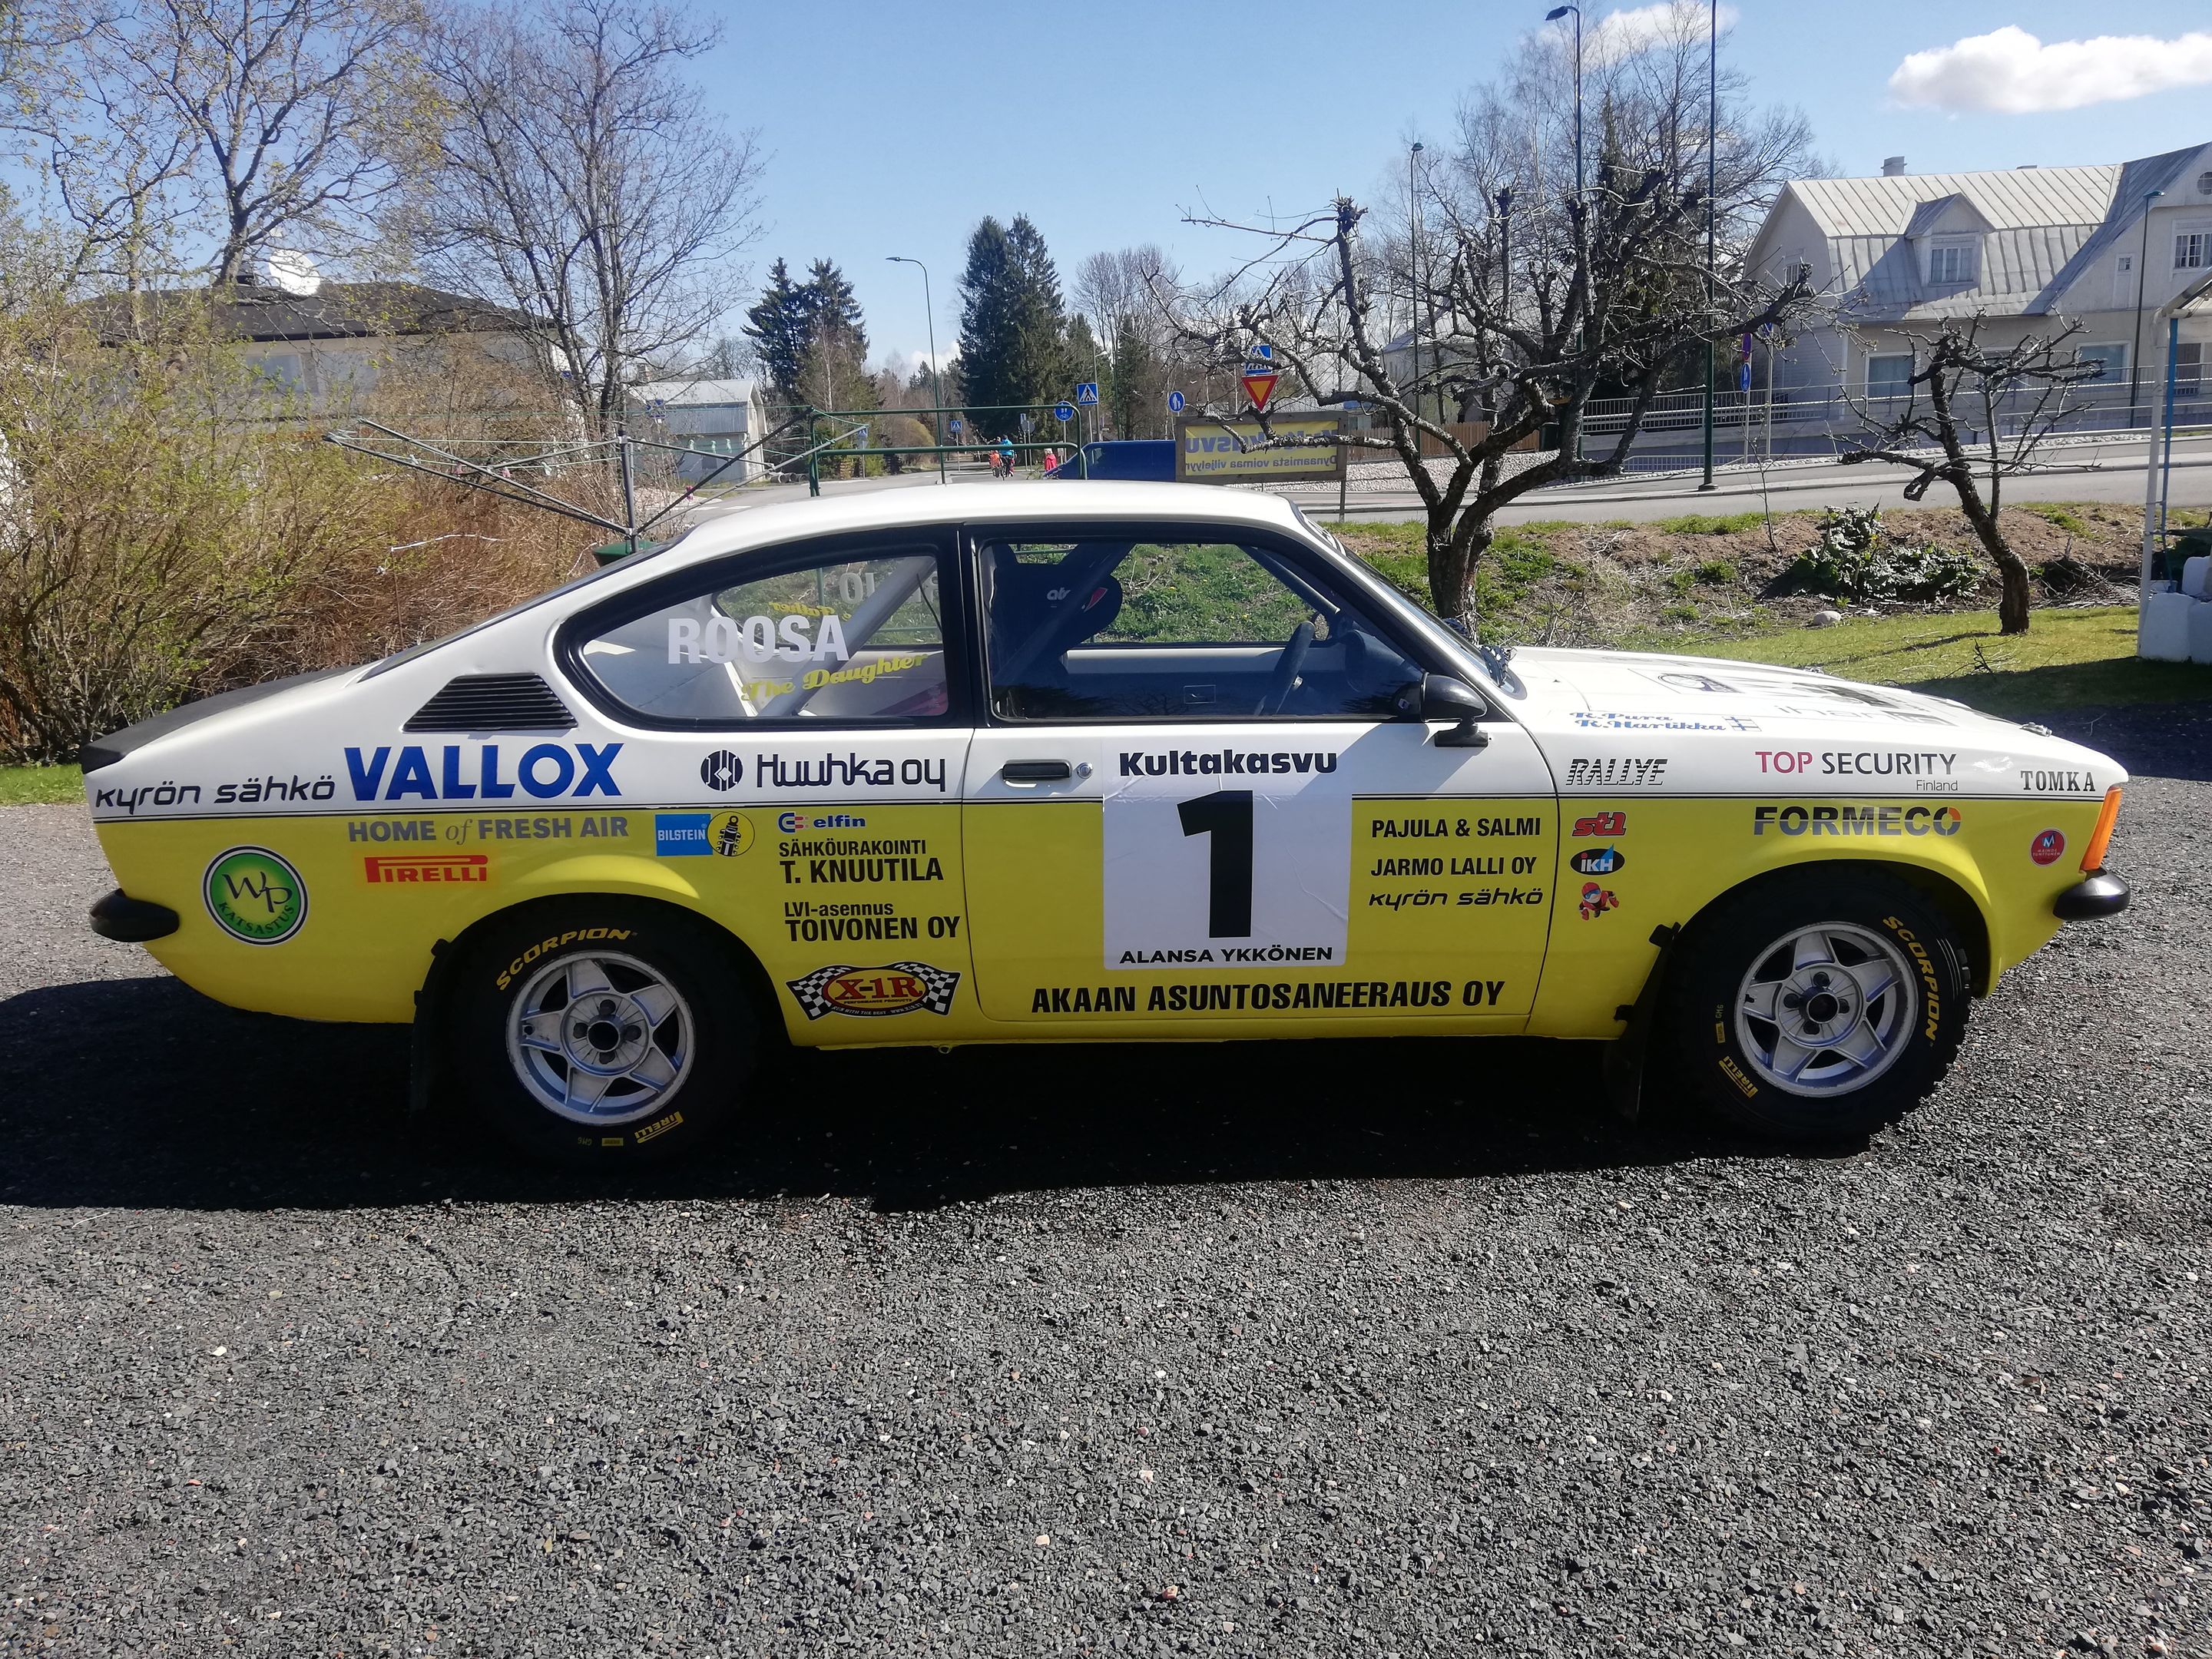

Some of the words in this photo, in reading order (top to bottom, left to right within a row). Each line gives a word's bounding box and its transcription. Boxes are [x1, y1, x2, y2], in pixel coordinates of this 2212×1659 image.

[667, 615, 849, 665] ROOSA
[740, 681, 796, 702] The
[803, 654, 928, 690] Daughter
[344, 743, 624, 801] VALLOX
[1120, 750, 1337, 776] Kultakasvu
[1565, 758, 1668, 786] RALLYE
[1755, 751, 1813, 773] TOP
[1822, 752, 1957, 775] SECURITY
[1916, 780, 1959, 791] Finland
[2021, 770, 2096, 792] TOMKA
[95, 781, 200, 815] kyrön
[214, 775, 336, 805] sähkö
[349, 822, 436, 843] HOME
[445, 817, 473, 846] of
[478, 817, 571, 839] FRESH
[580, 816, 628, 838] AIR
[813, 813, 866, 828] elfin
[1372, 819, 1448, 838] PAJULA
[1455, 819, 1470, 836] &
[1477, 817, 1541, 836] SALMI
[1754, 806, 1961, 836] FORMECO
[658, 829, 706, 842] BILSTEIN
[779, 840, 926, 857] SÄHKÖURAKOINTI
[364, 855, 488, 883] PIRELLI
[780, 859, 801, 884] T.
[810, 858, 944, 883] KNUUTILA
[1177, 790, 1253, 939] 1
[1371, 857, 1443, 876] JARMO
[1450, 857, 1504, 876] LALLI
[1512, 856, 1536, 874] OY
[784, 902, 894, 917] LVI-asennus
[1369, 889, 1447, 912] kyrön
[1455, 887, 1544, 906] sähkö
[218, 902, 295, 934] KATSASTUS
[785, 918, 918, 942] TOIVONEN
[928, 916, 960, 939] OY
[495, 927, 632, 990] SCORPION
[1119, 949, 1214, 964] ALANSA
[1220, 945, 1333, 962] YKKÖNEN
[835, 976, 922, 1000] X-1R
[1883, 915, 1942, 1041] SCORPION
[1031, 986, 1135, 1013] AKAAN
[1147, 981, 1452, 1011] ASUNTOSANEERAUS
[1462, 980, 1505, 1006] OY
[1718, 1055, 1759, 1098] PIRELLI
[634, 1111, 684, 1144] PIRELLI
